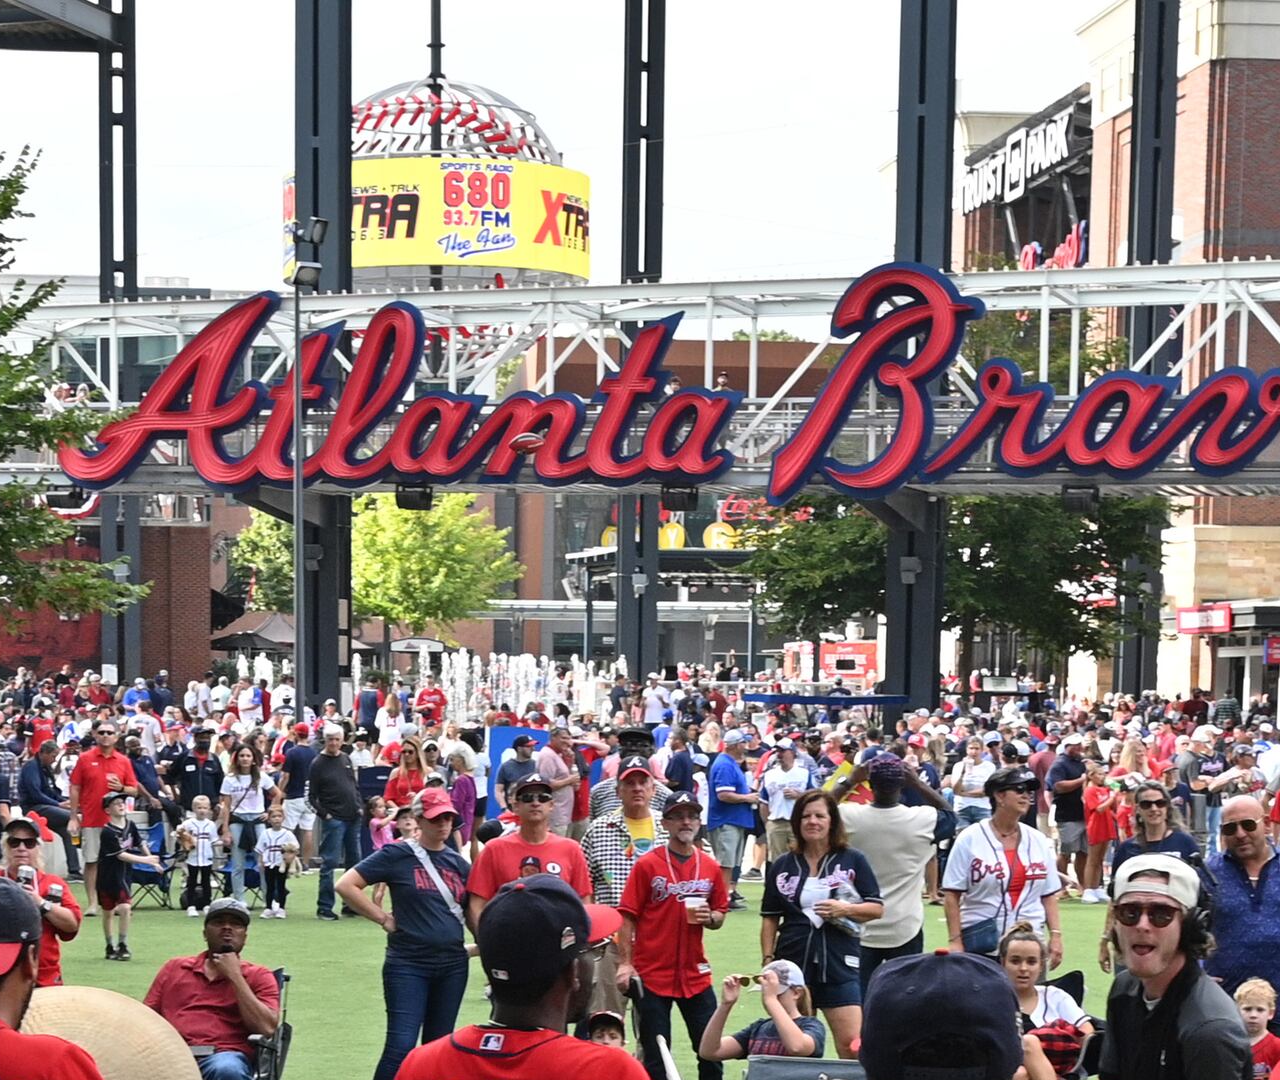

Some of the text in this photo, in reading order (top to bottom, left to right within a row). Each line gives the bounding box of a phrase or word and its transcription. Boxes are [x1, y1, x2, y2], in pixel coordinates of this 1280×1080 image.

[1026, 114, 1069, 178] PARK
[440, 162, 513, 173] SPORTS RADIO
[391, 184, 420, 193] TALK
[443, 171, 511, 209] 680
[437, 231, 471, 254] The
[57, 289, 743, 493] Atlanta
